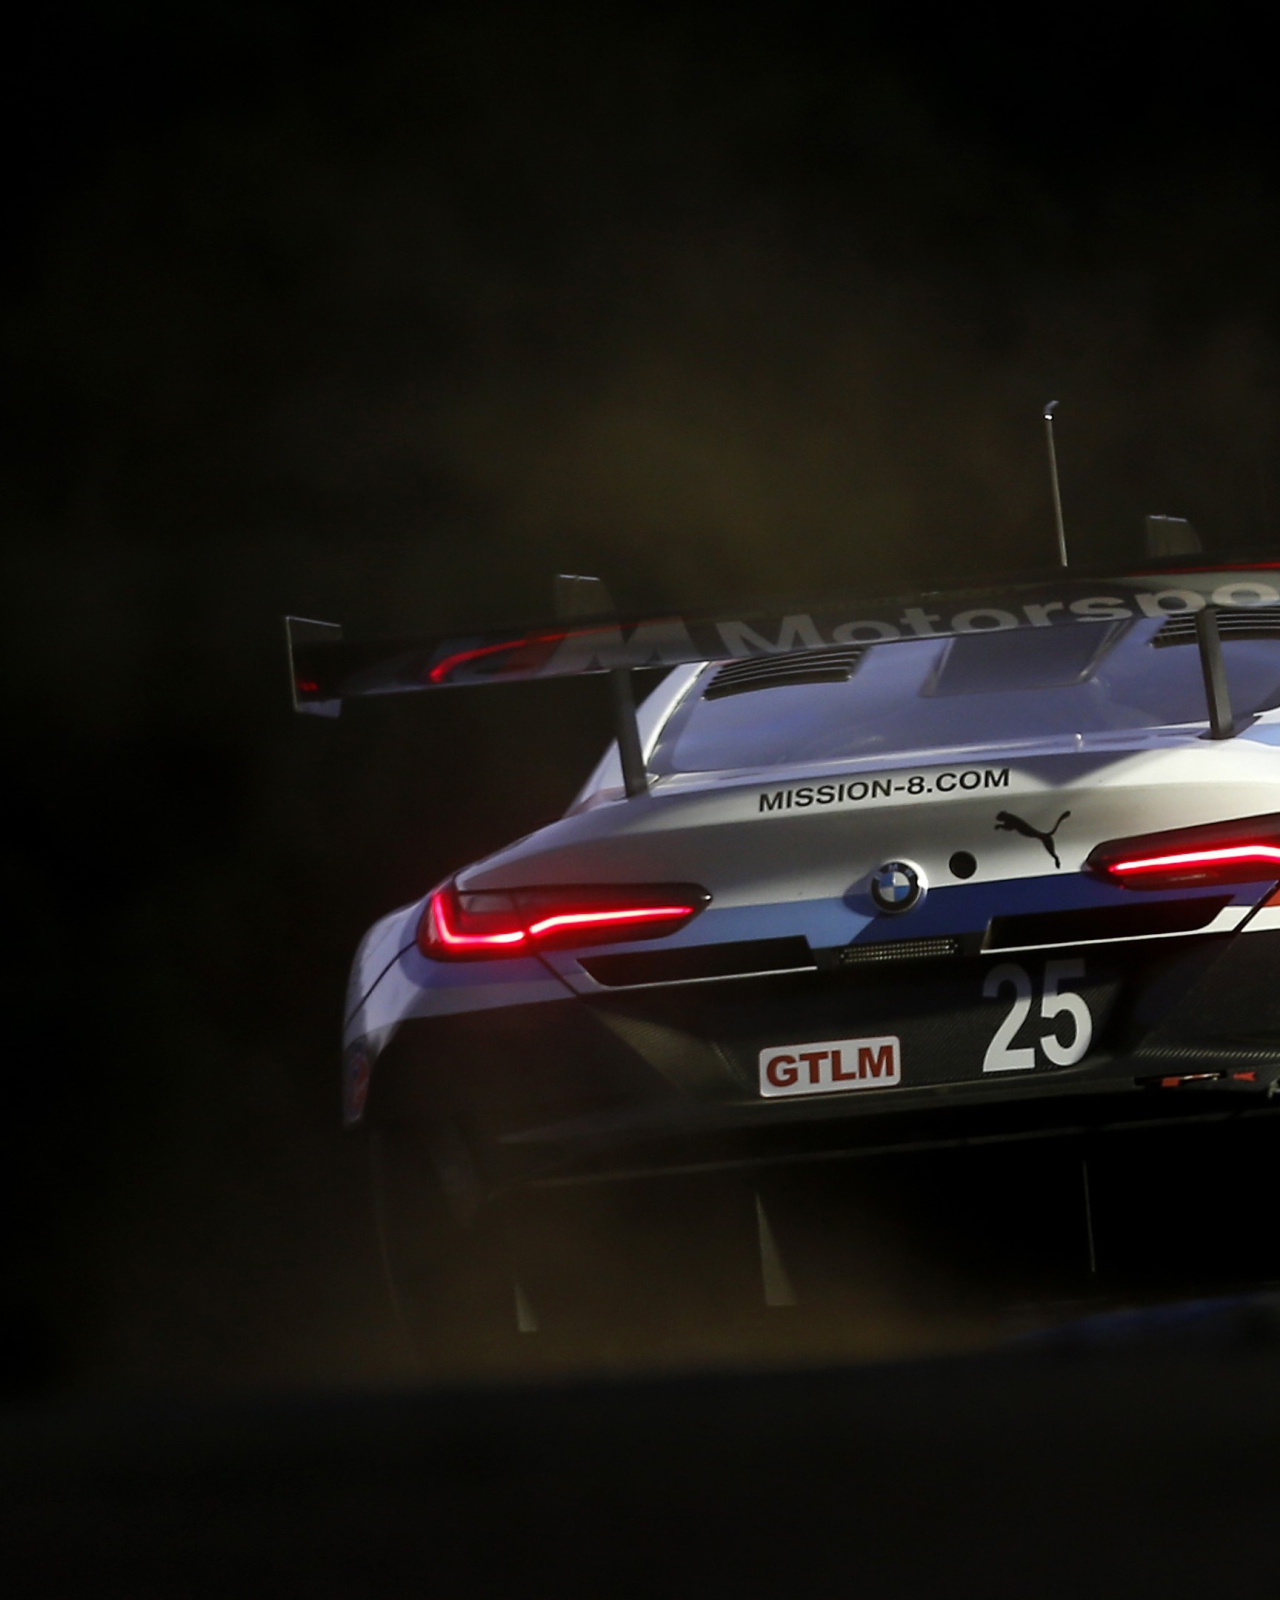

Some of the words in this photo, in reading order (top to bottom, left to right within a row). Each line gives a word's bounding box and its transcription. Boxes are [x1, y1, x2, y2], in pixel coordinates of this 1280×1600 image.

[758, 768, 1010, 812] MISSION-8.COM
[982, 957, 1093, 1073] 25
[766, 1045, 894, 1087] GTLM
